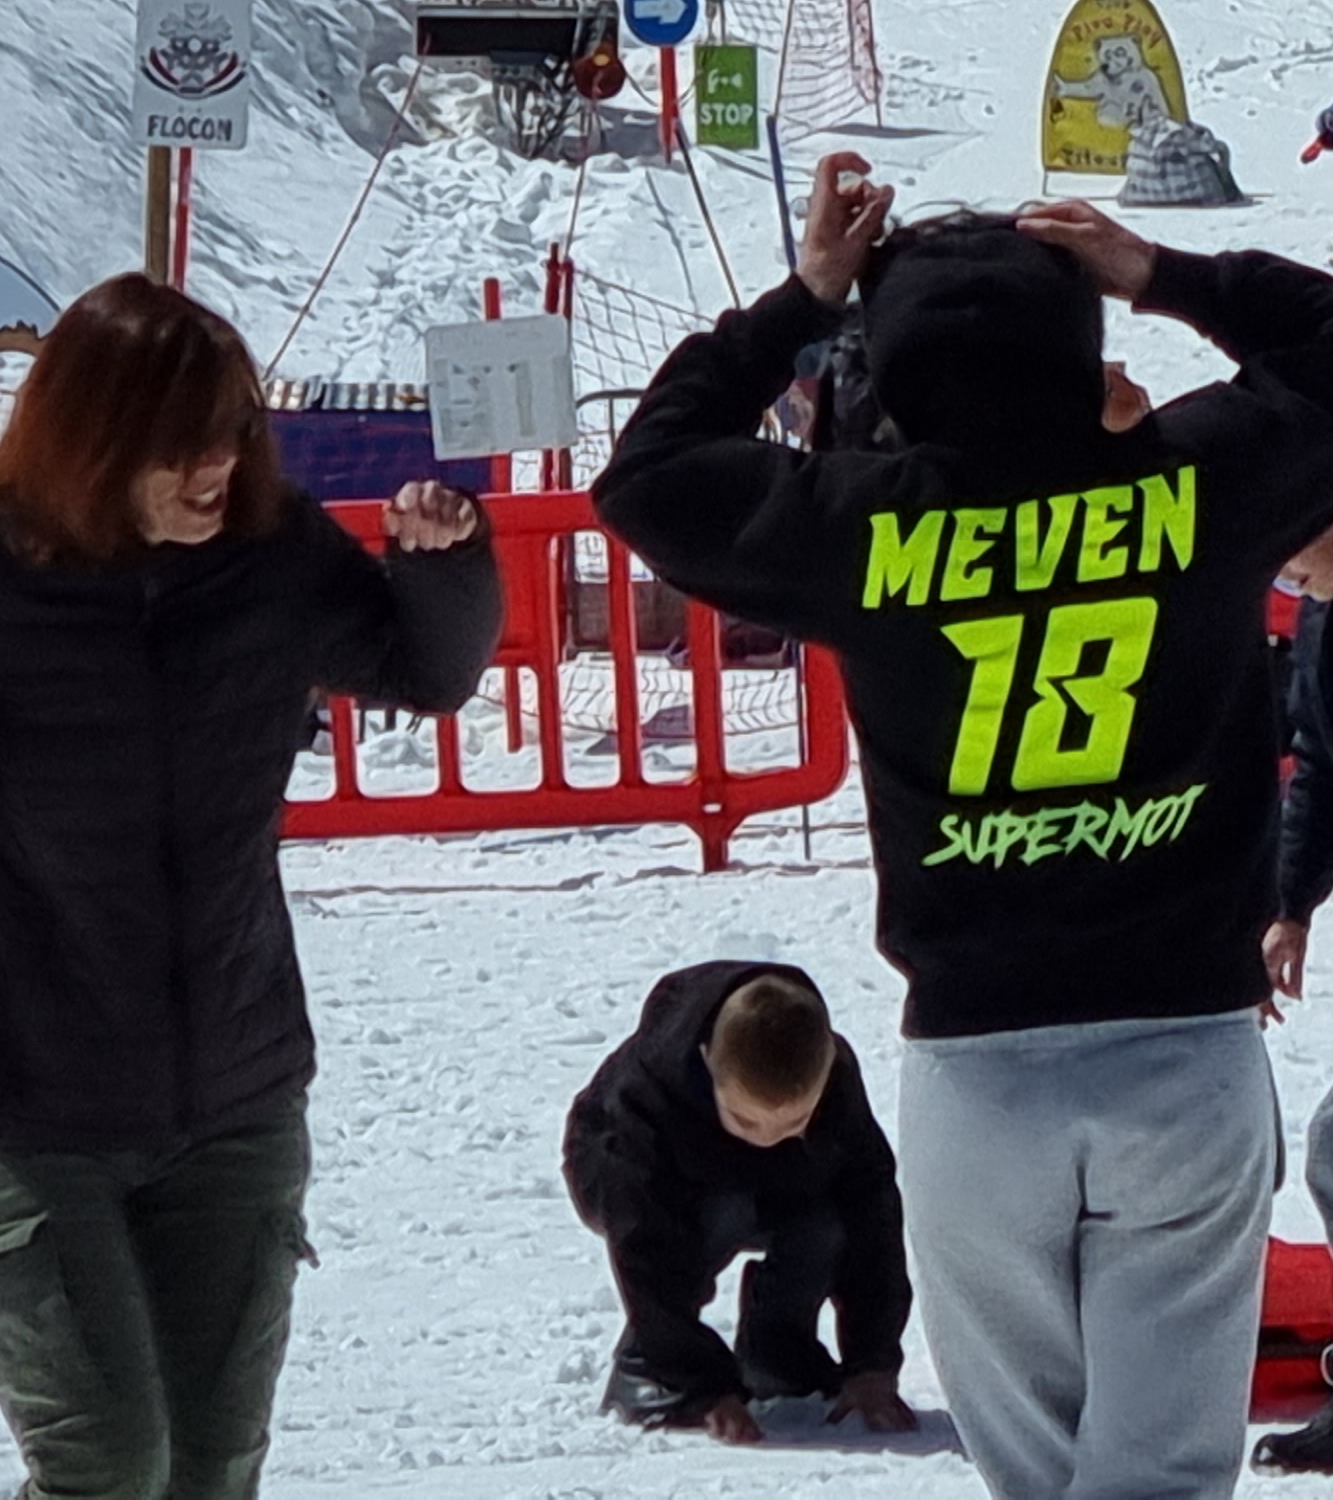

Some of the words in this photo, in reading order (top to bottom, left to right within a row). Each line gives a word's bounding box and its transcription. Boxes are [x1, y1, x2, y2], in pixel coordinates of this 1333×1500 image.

[147, 114, 232, 142] FLOCON
[700, 102, 754, 126] STOP
[862, 465, 1197, 609] MEVEN
[940, 596, 1158, 797] 18
